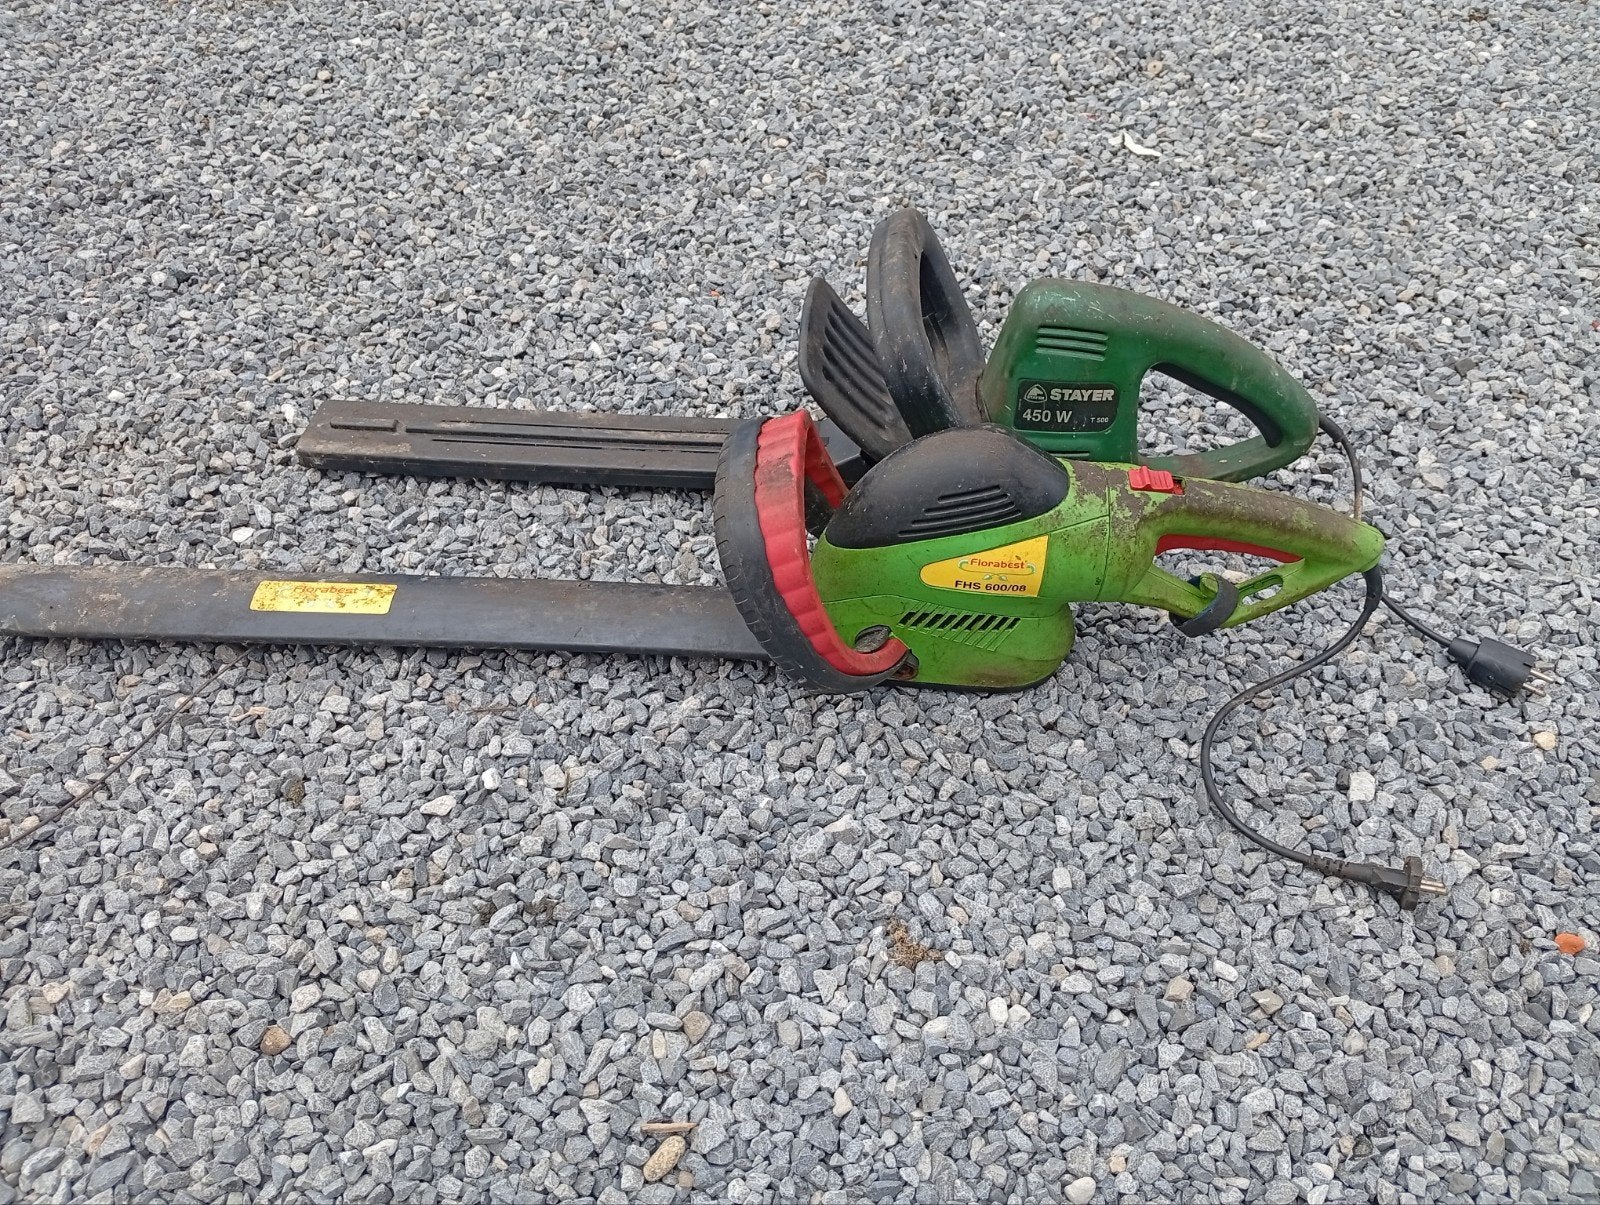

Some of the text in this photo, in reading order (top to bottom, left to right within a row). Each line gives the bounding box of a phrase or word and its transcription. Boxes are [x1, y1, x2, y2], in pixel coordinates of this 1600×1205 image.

[1050, 388, 1115, 401] STAYER
[1022, 408, 1073, 423] 450 W
[970, 558, 1026, 569] Florabest
[293, 585, 359, 594] Florabest
[955, 580, 1027, 592] FHS 600/08
